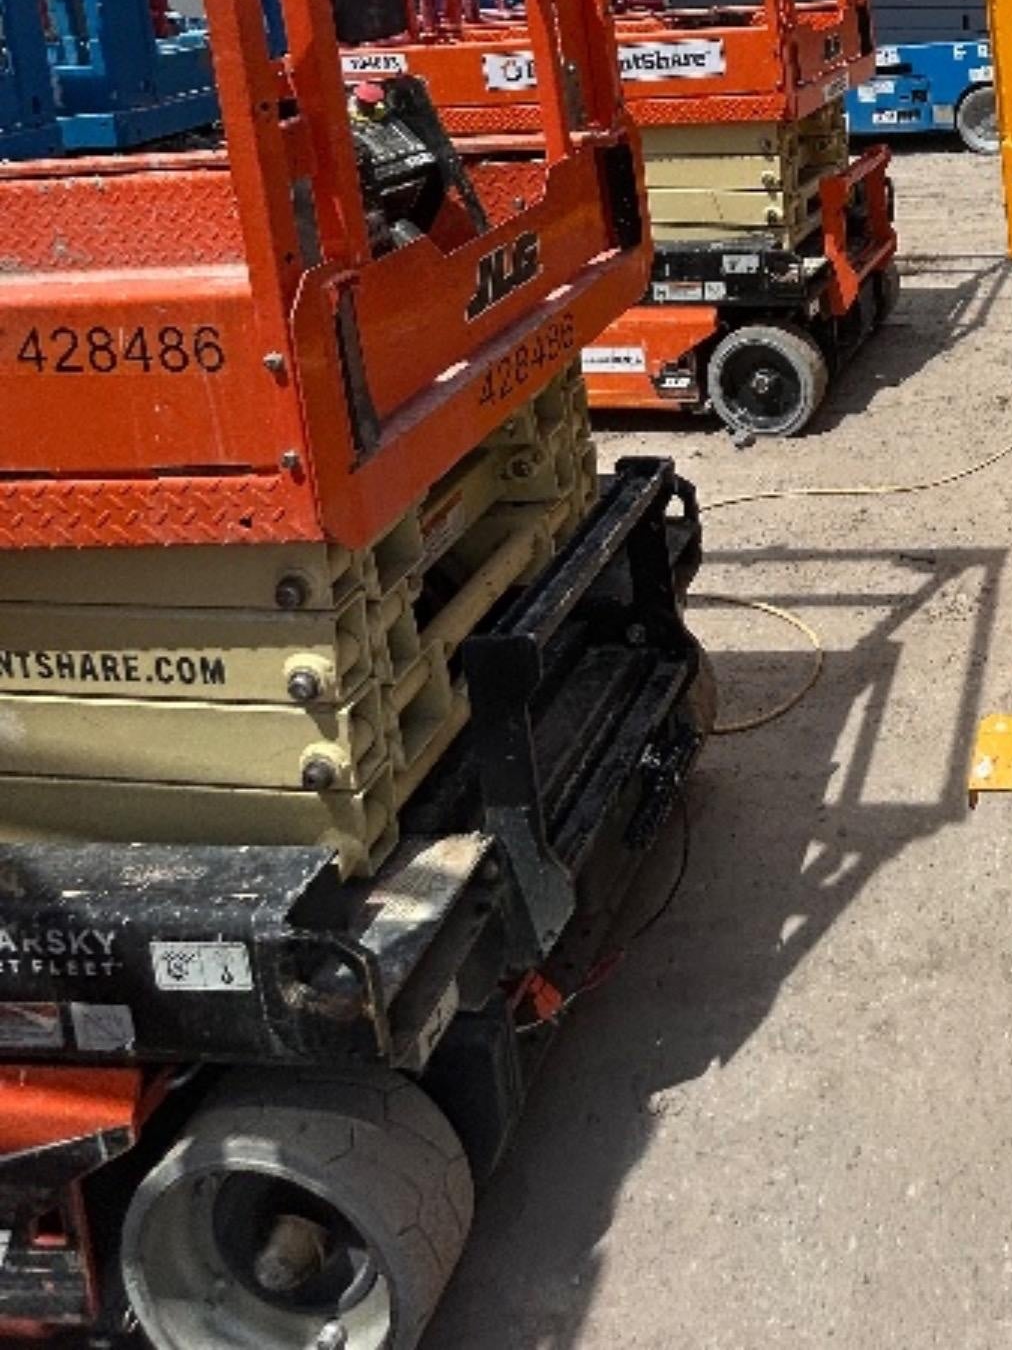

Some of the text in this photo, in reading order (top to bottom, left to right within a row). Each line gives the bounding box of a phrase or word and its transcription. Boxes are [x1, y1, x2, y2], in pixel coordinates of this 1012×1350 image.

[464, 229, 544, 325] JLG
[16, 325, 226, 373] 428486
[478, 313, 576, 407] 428486
